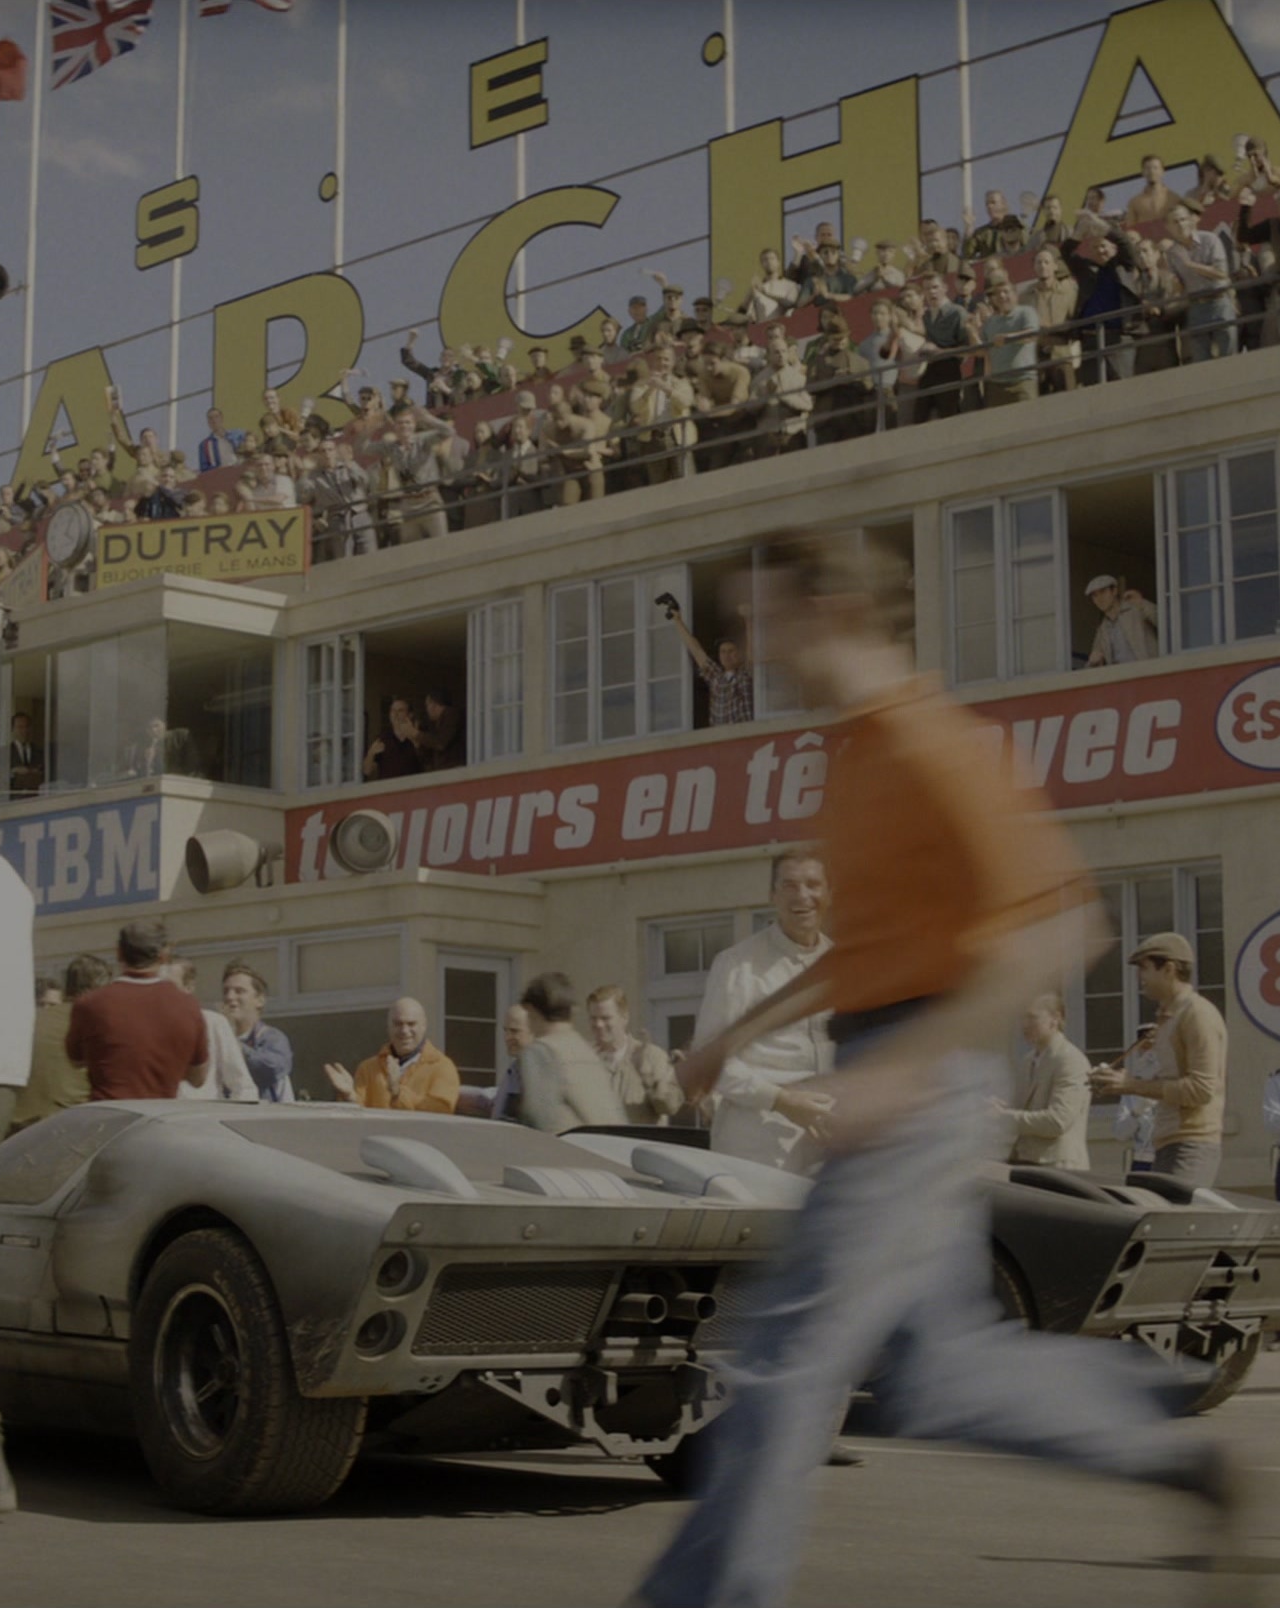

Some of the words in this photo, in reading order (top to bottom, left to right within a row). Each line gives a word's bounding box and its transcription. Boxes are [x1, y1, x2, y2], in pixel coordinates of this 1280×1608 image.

[103, 515, 300, 565] DUTRAY
[218, 558, 241, 573] LE
[246, 553, 299, 570] MANS
[621, 765, 714, 840] en
[745, 731, 828, 825] tê
[19, 803, 158, 905] IBM
